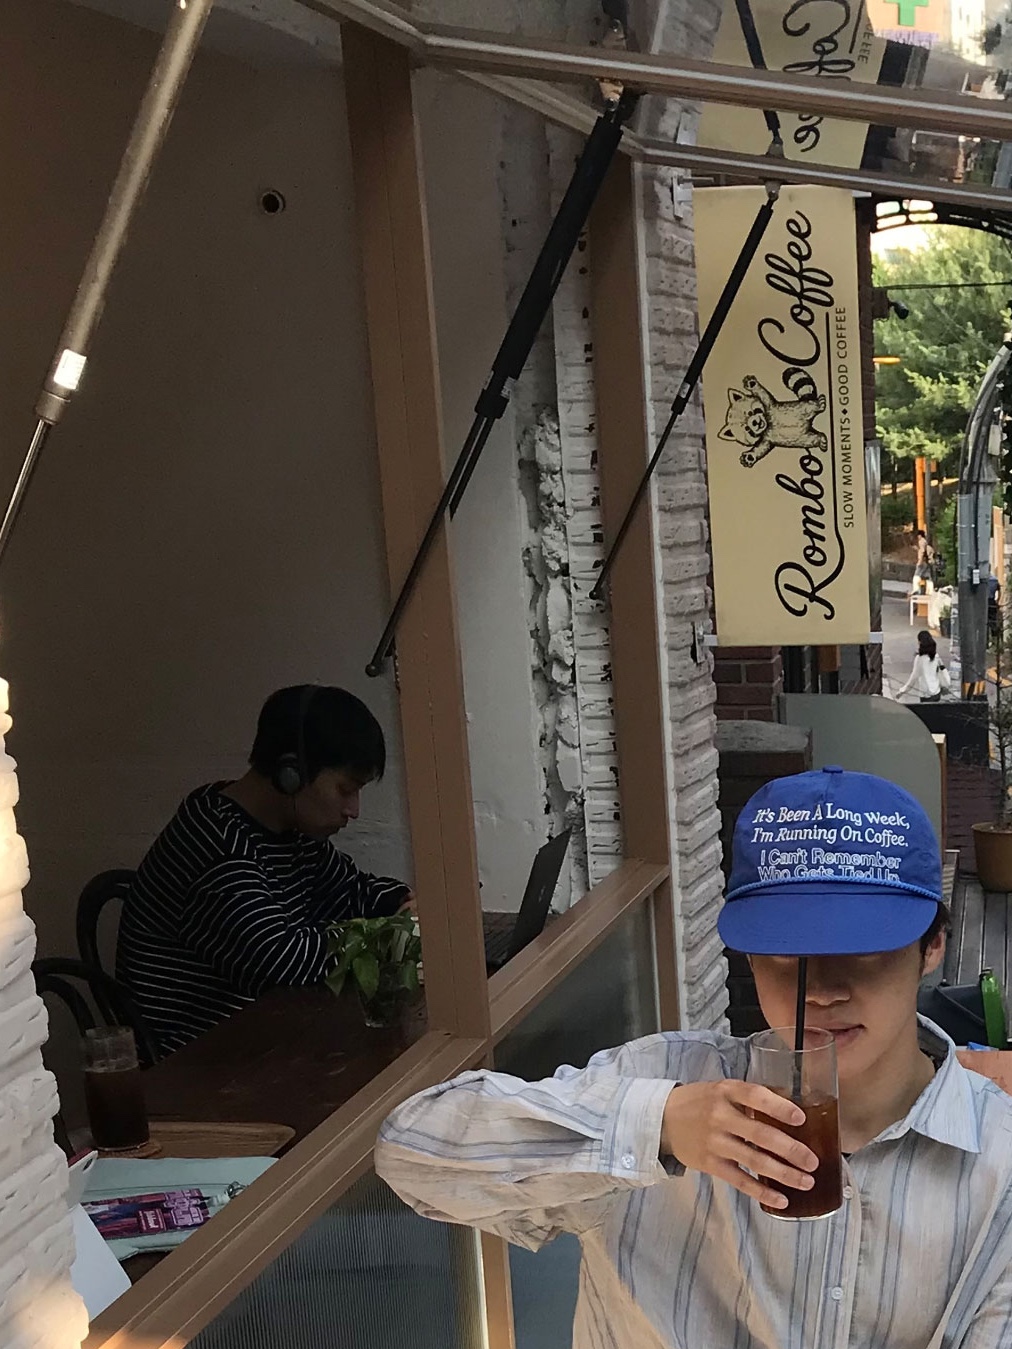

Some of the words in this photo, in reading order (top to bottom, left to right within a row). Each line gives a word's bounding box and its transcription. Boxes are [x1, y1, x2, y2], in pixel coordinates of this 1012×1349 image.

[757, 210, 835, 367] Coffee
[835, 307, 848, 359] COFFEE
[838, 364, 849, 406] GOOD
[840, 417, 853, 486] MOMENTS
[844, 491, 854, 528] SLOW
[774, 448, 845, 620] Rombo
[751, 827, 774, 843] I'm
[775, 824, 837, 844] Running
[840, 825, 864, 842] On
[865, 828, 908, 847] Coffee.
[752, 808, 775, 823] It's
[777, 807, 811, 823] Been
[812, 804, 823, 820] A
[826, 803, 862, 826] Long
[864, 811, 910, 829] Week,
[761, 849, 766, 866] I
[768, 847, 808, 866] Can't
[811, 847, 902, 869] Remember
